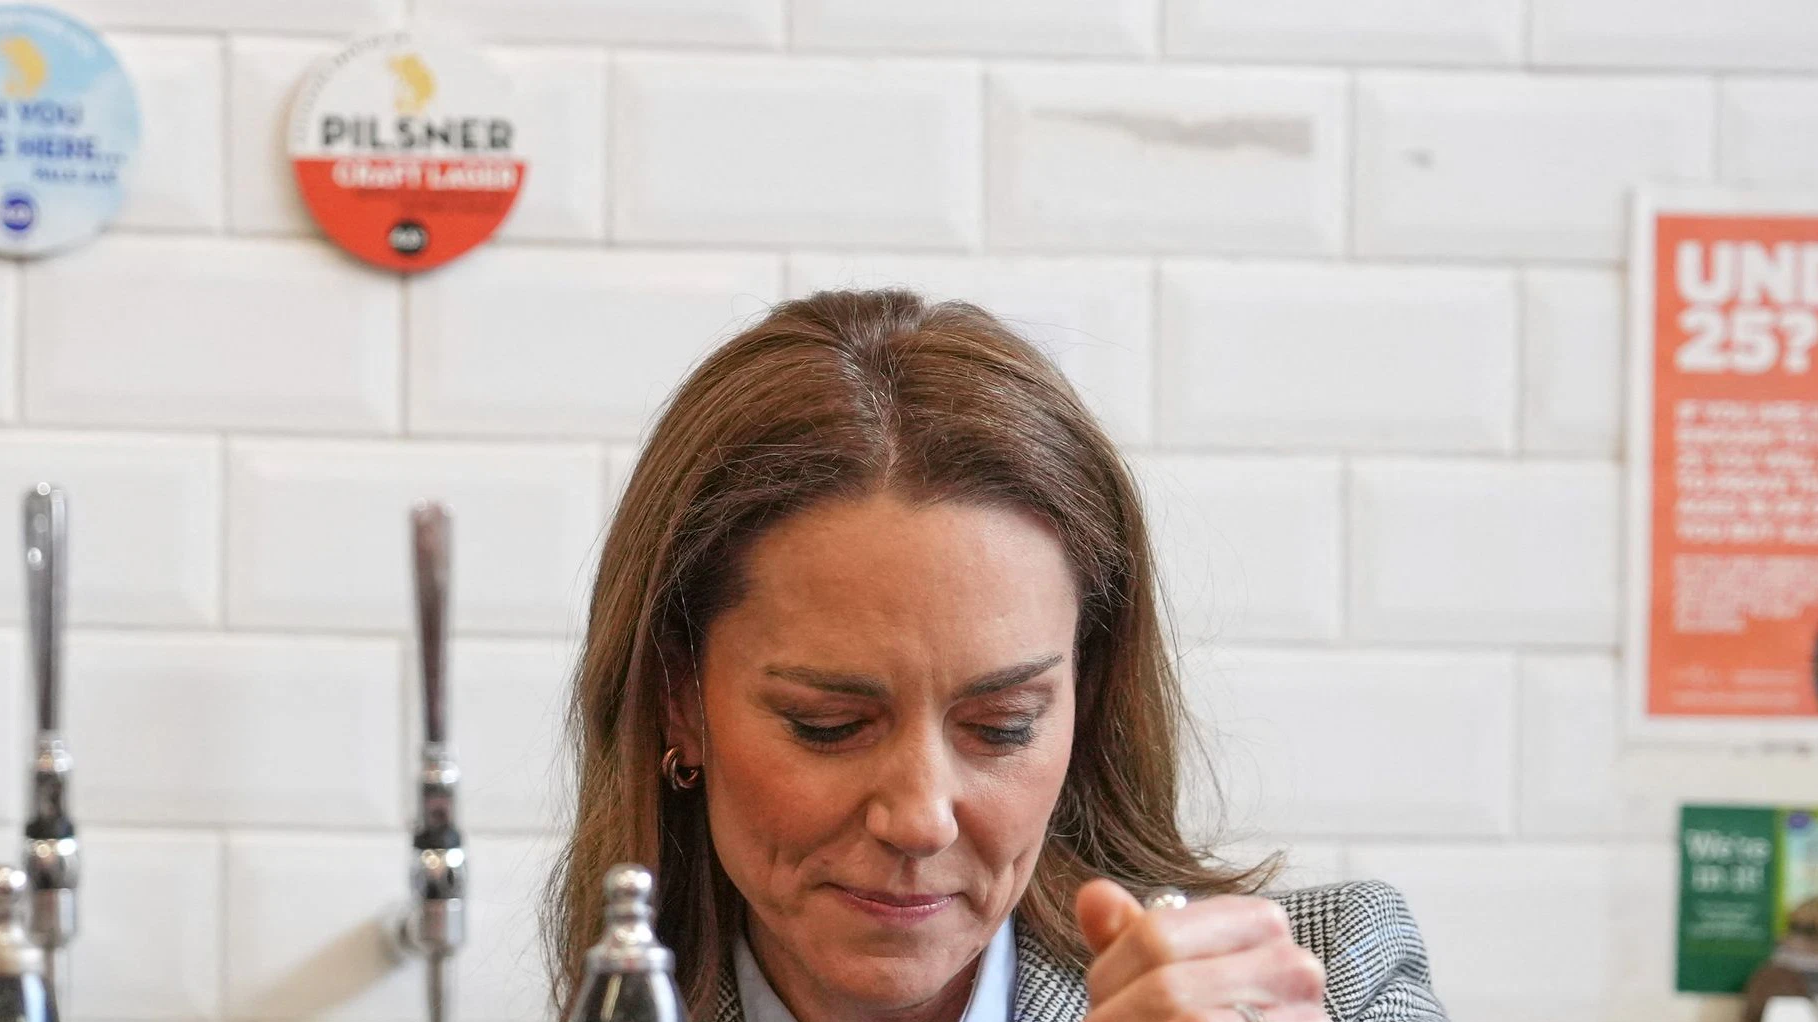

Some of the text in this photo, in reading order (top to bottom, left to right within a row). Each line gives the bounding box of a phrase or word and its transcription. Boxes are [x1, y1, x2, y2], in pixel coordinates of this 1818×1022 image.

[15, 99, 84, 127] YOU
[321, 115, 515, 150] PILSNER
[332, 158, 519, 191] CRAFT LAGER
[1674, 308, 1818, 374] 25?
